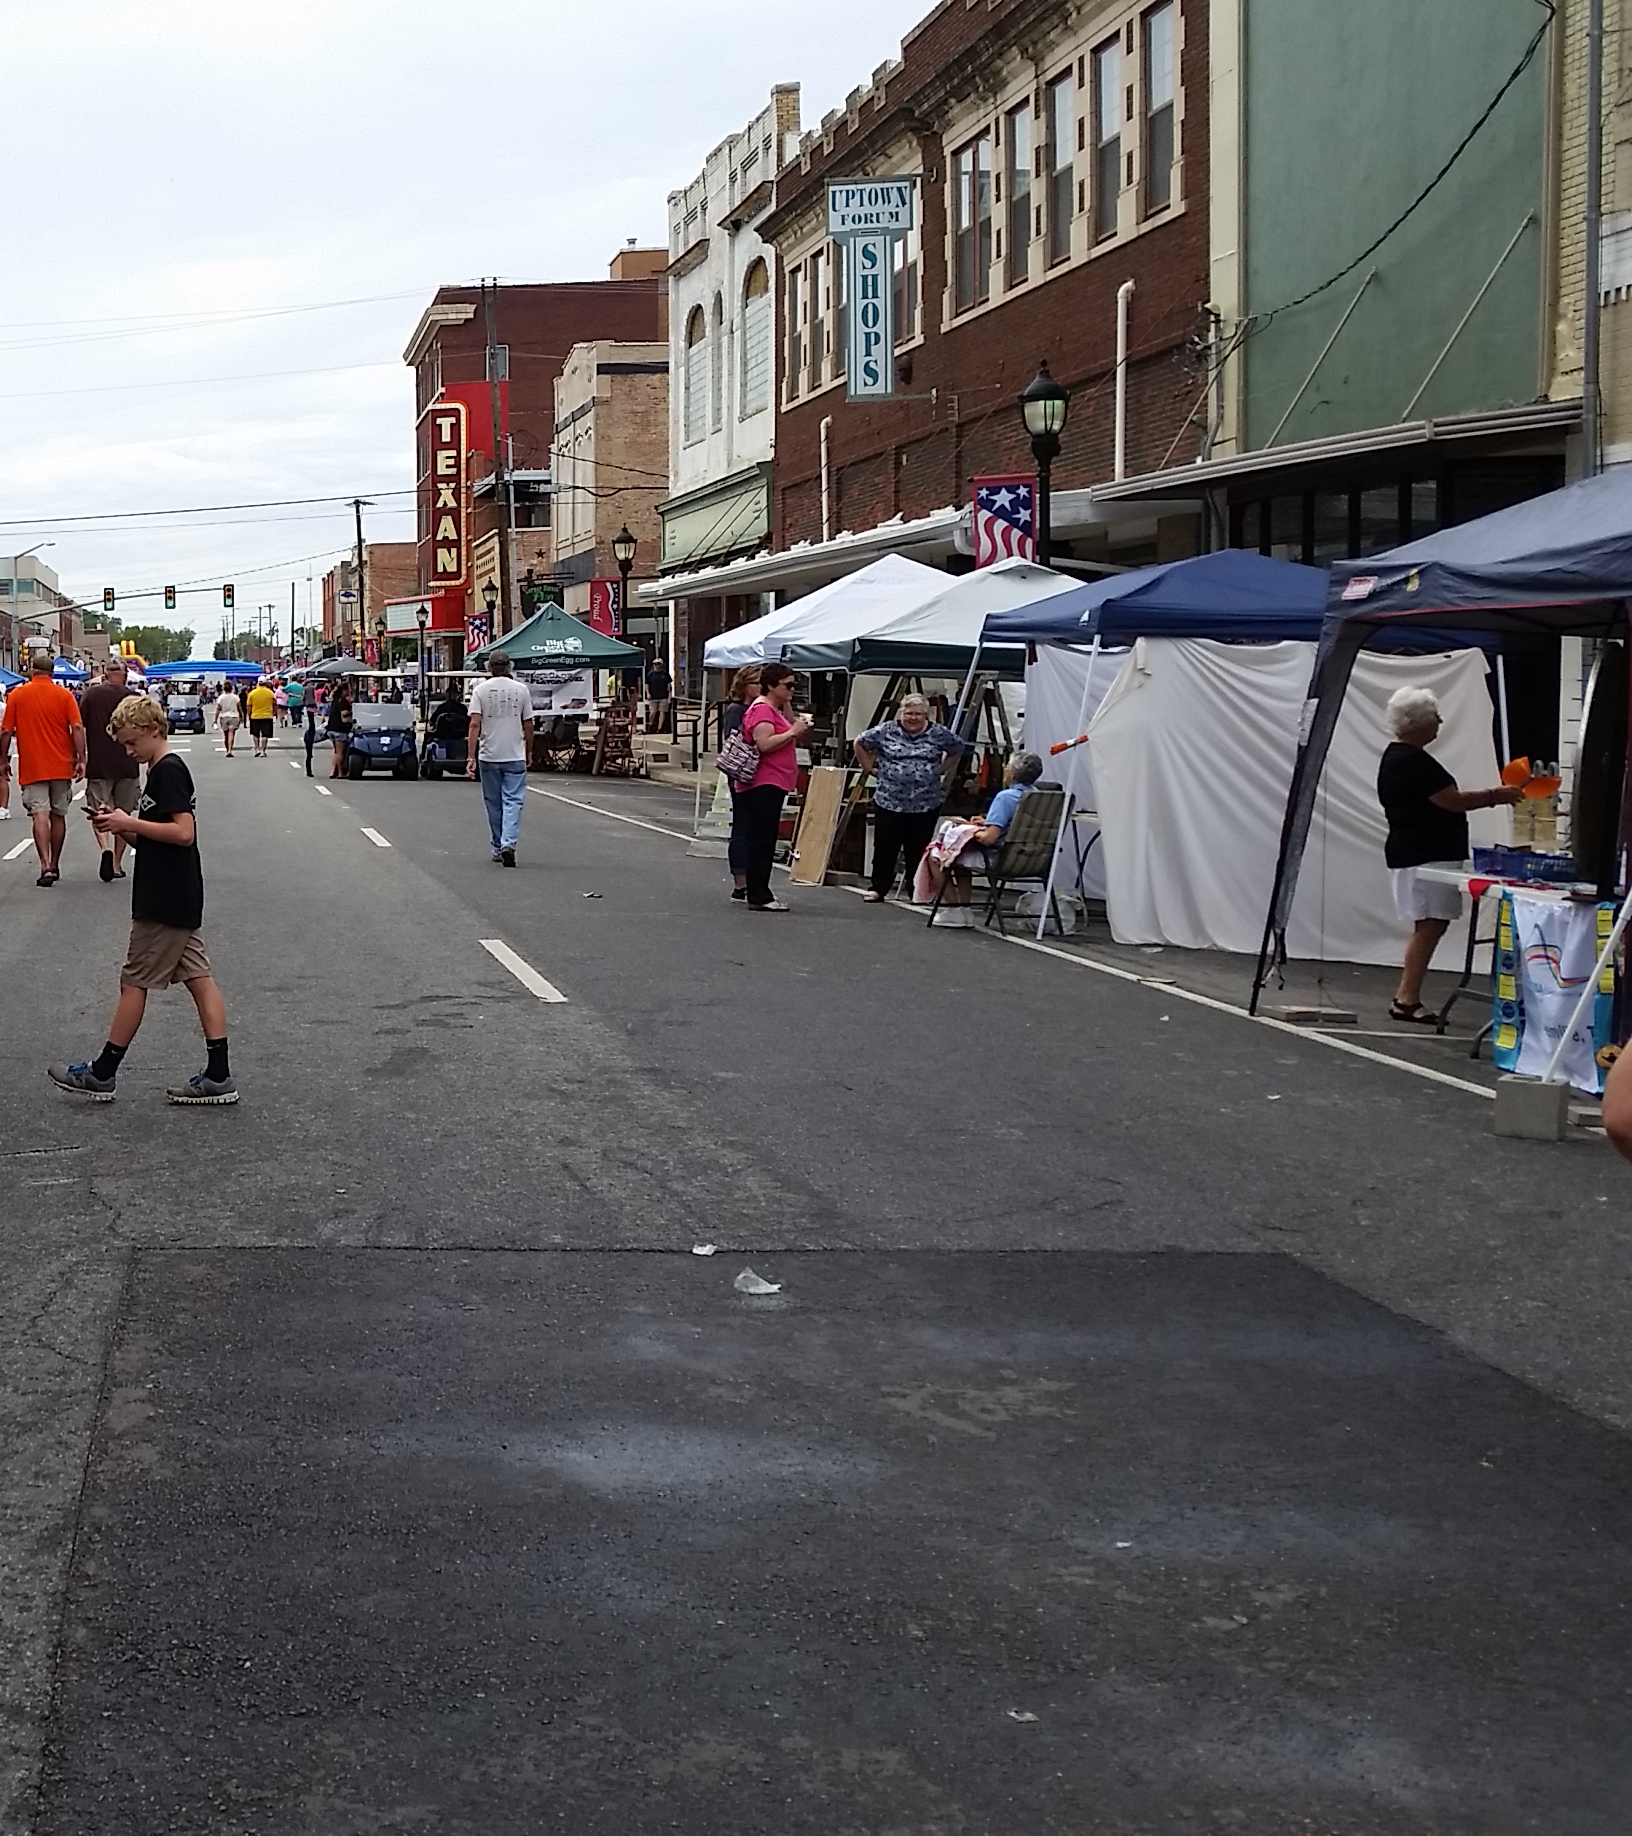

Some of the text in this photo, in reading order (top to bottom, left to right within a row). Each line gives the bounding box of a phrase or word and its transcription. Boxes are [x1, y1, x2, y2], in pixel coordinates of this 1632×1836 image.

[830, 185, 909, 213] UPTOWN
[840, 211, 900, 226] FORUM
[860, 242, 881, 388] SHOPS
[435, 417, 459, 573] TEXAN
[593, 592, 603, 622] Proud
